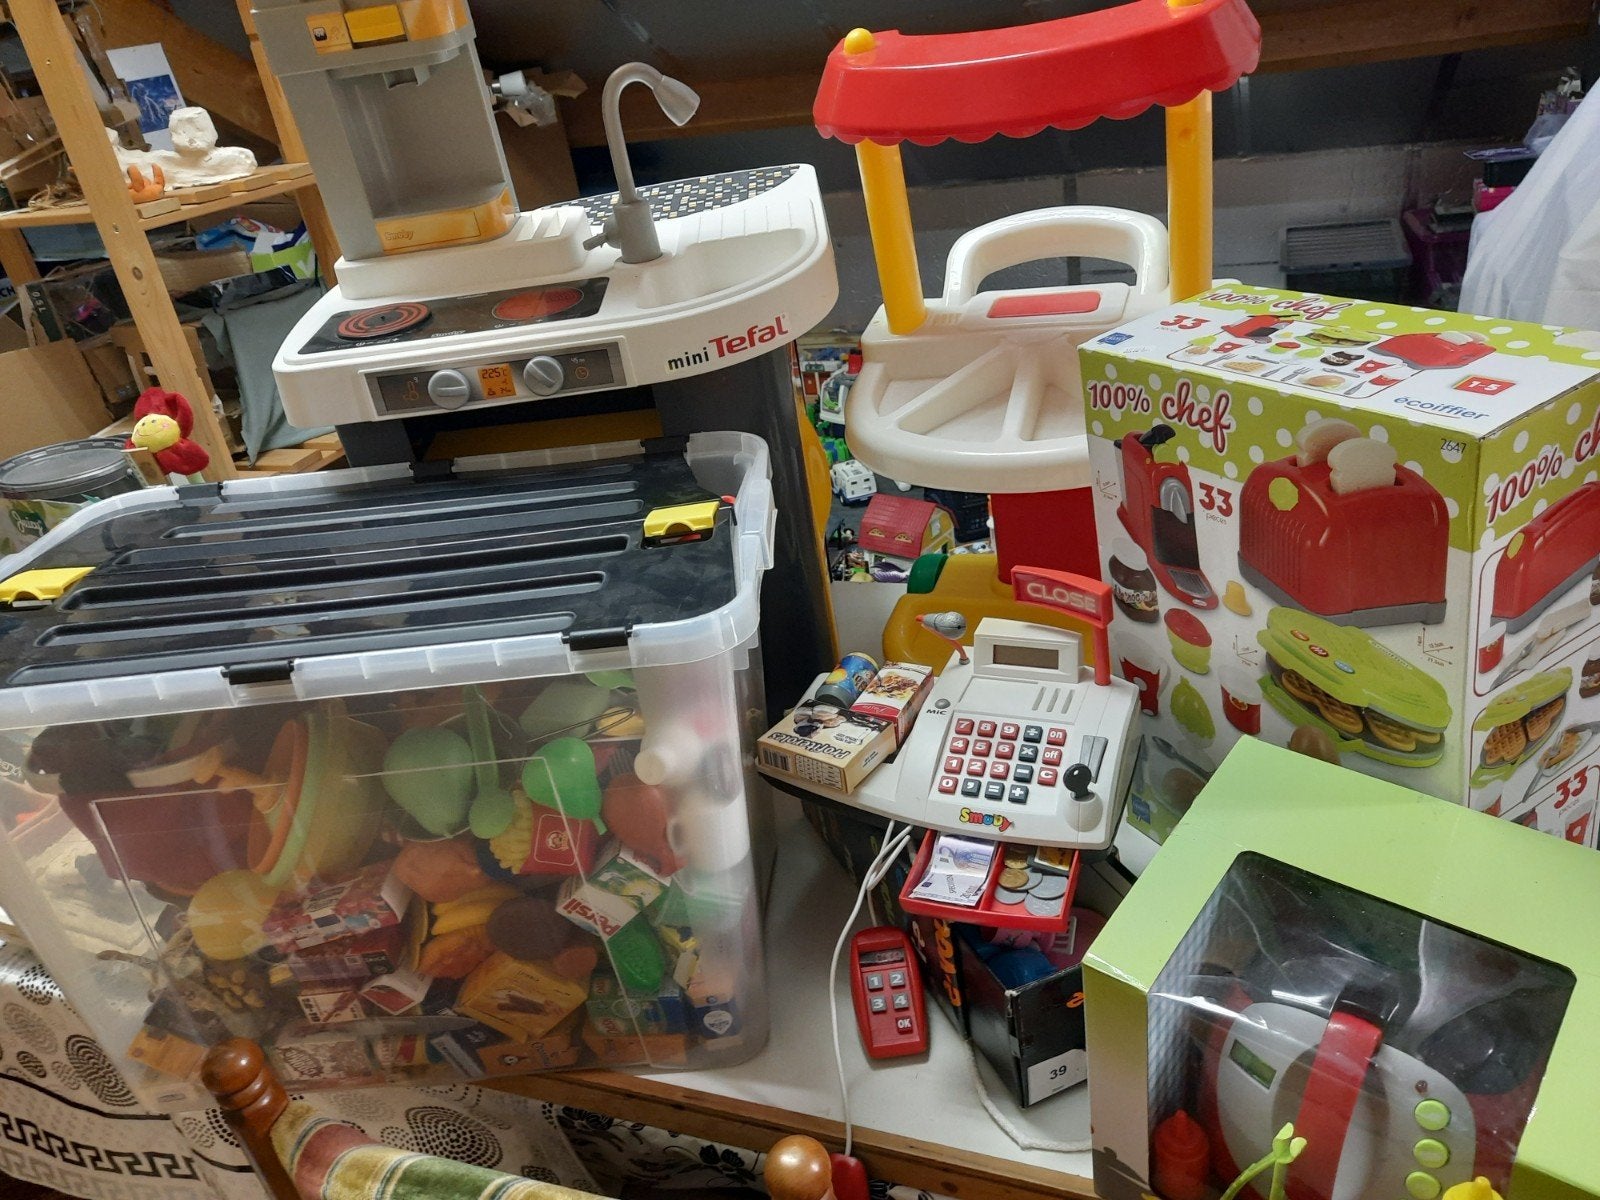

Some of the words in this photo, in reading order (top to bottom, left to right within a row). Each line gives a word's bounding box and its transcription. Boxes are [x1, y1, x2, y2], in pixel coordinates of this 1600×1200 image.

[1202, 292, 1267, 305] 100%
[1272, 297, 1354, 321] chef
[1159, 314, 1211, 330] 33
[667, 346, 709, 371] mini
[708, 316, 789, 359] Tefal
[1468, 380, 1502, 391] 1-5
[1088, 382, 1151, 414] 100%
[1160, 381, 1232, 454] chef
[1393, 396, 1491, 420] écoiffier
[1440, 438, 1467, 454] 2647
[1486, 447, 1563, 524] 100%
[1198, 481, 1234, 518] 33
[1026, 582, 1098, 614] CLOSE
[1049, 730, 1063, 739] on
[1044, 750, 1060, 759] off
[1553, 765, 1589, 810] 33
[562, 898, 621, 936] Persil
[891, 973, 903, 984] 2
[873, 998, 884, 1009] 3
[895, 995, 906, 1006] 4
[897, 1018, 912, 1029] OK
[1050, 1065, 1067, 1080] 39
